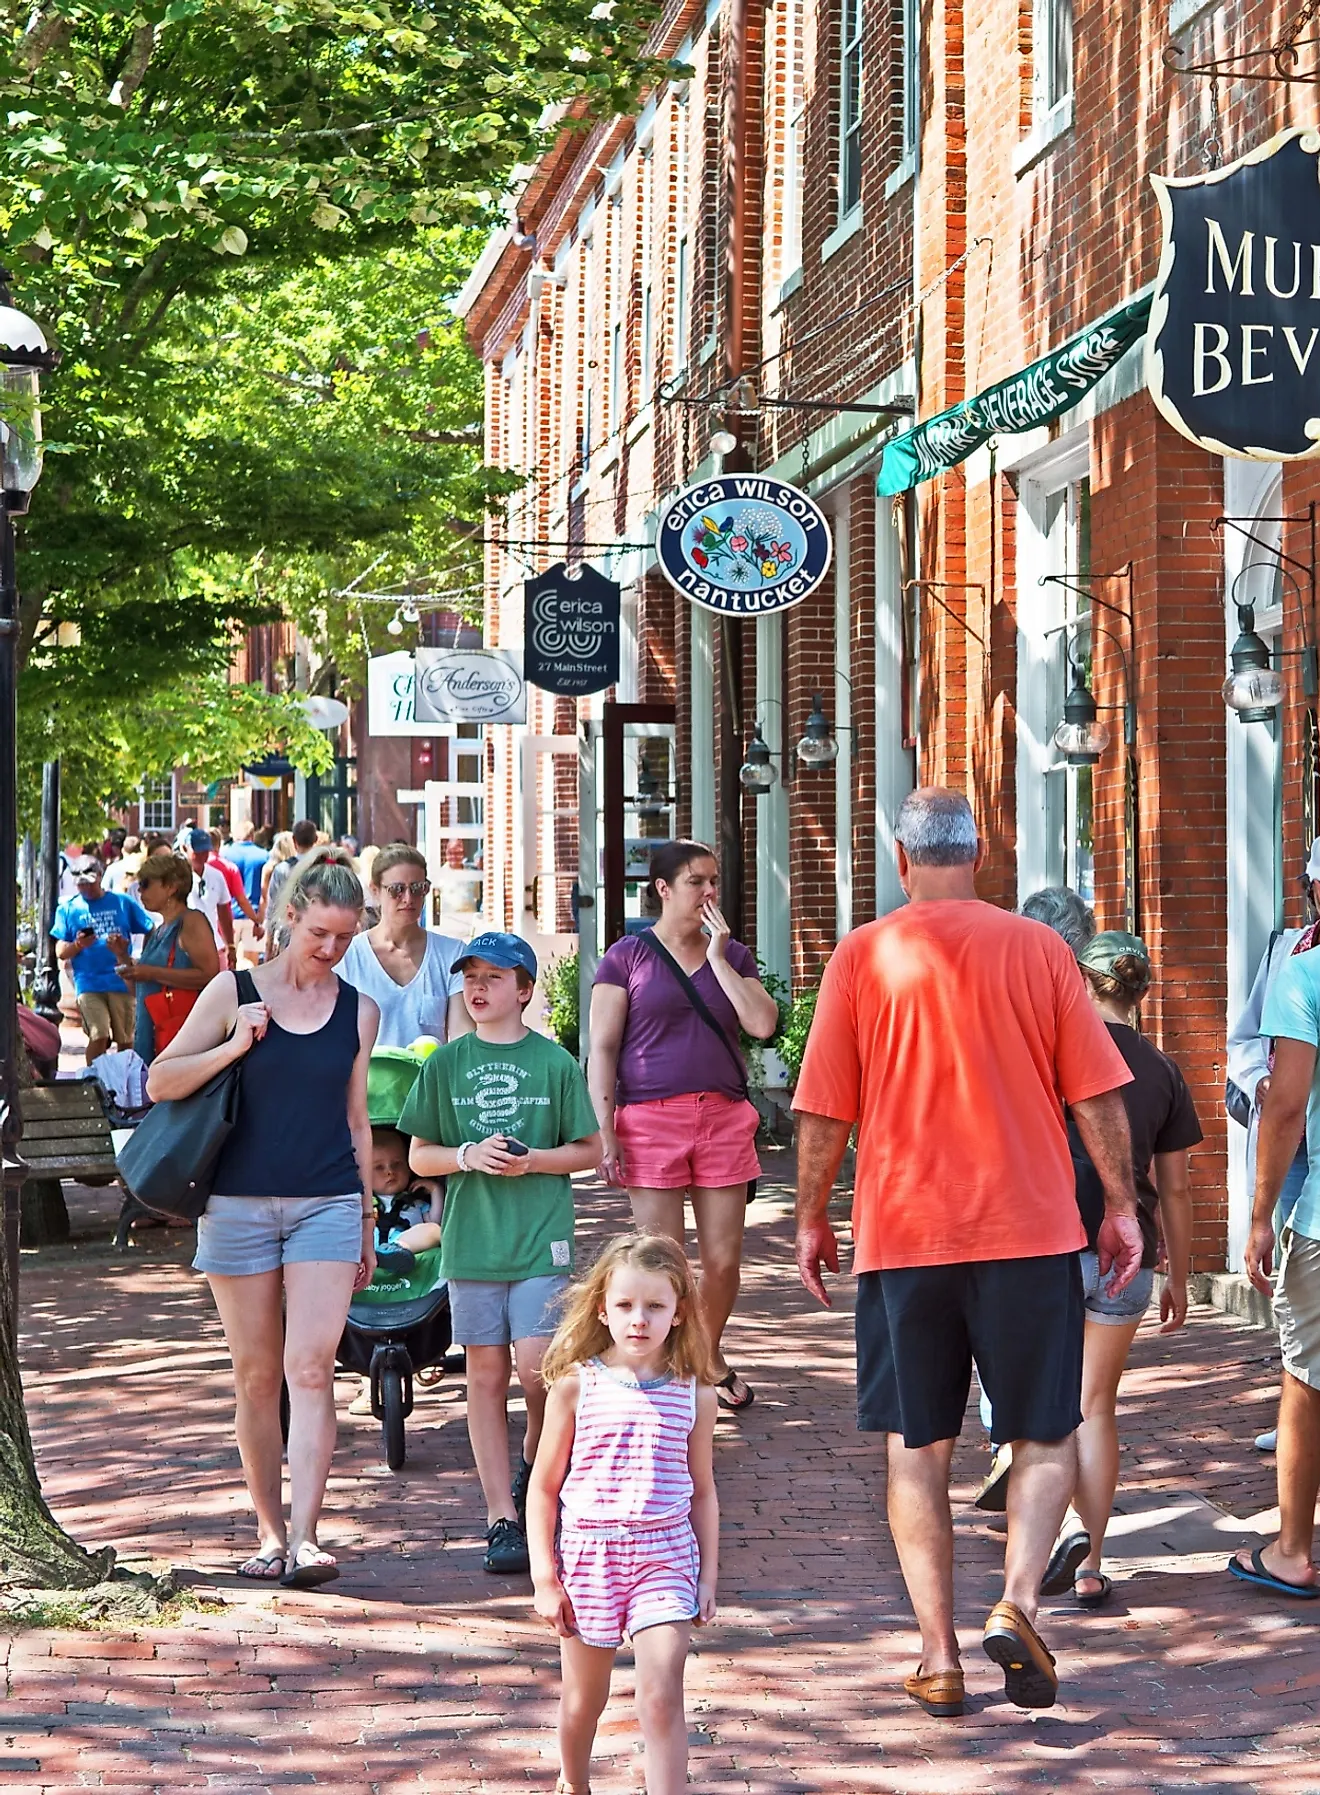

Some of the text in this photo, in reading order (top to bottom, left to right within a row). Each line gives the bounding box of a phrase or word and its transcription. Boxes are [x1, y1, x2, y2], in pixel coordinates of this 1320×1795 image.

[978, 362, 1068, 433] BEVERAGE
[677, 568, 815, 612] nantucket
[560, 598, 603, 614] erica
[560, 617, 615, 633] wilson
[426, 666, 516, 695] Anderson's
[1119, 946, 1146, 959] ORVIS
